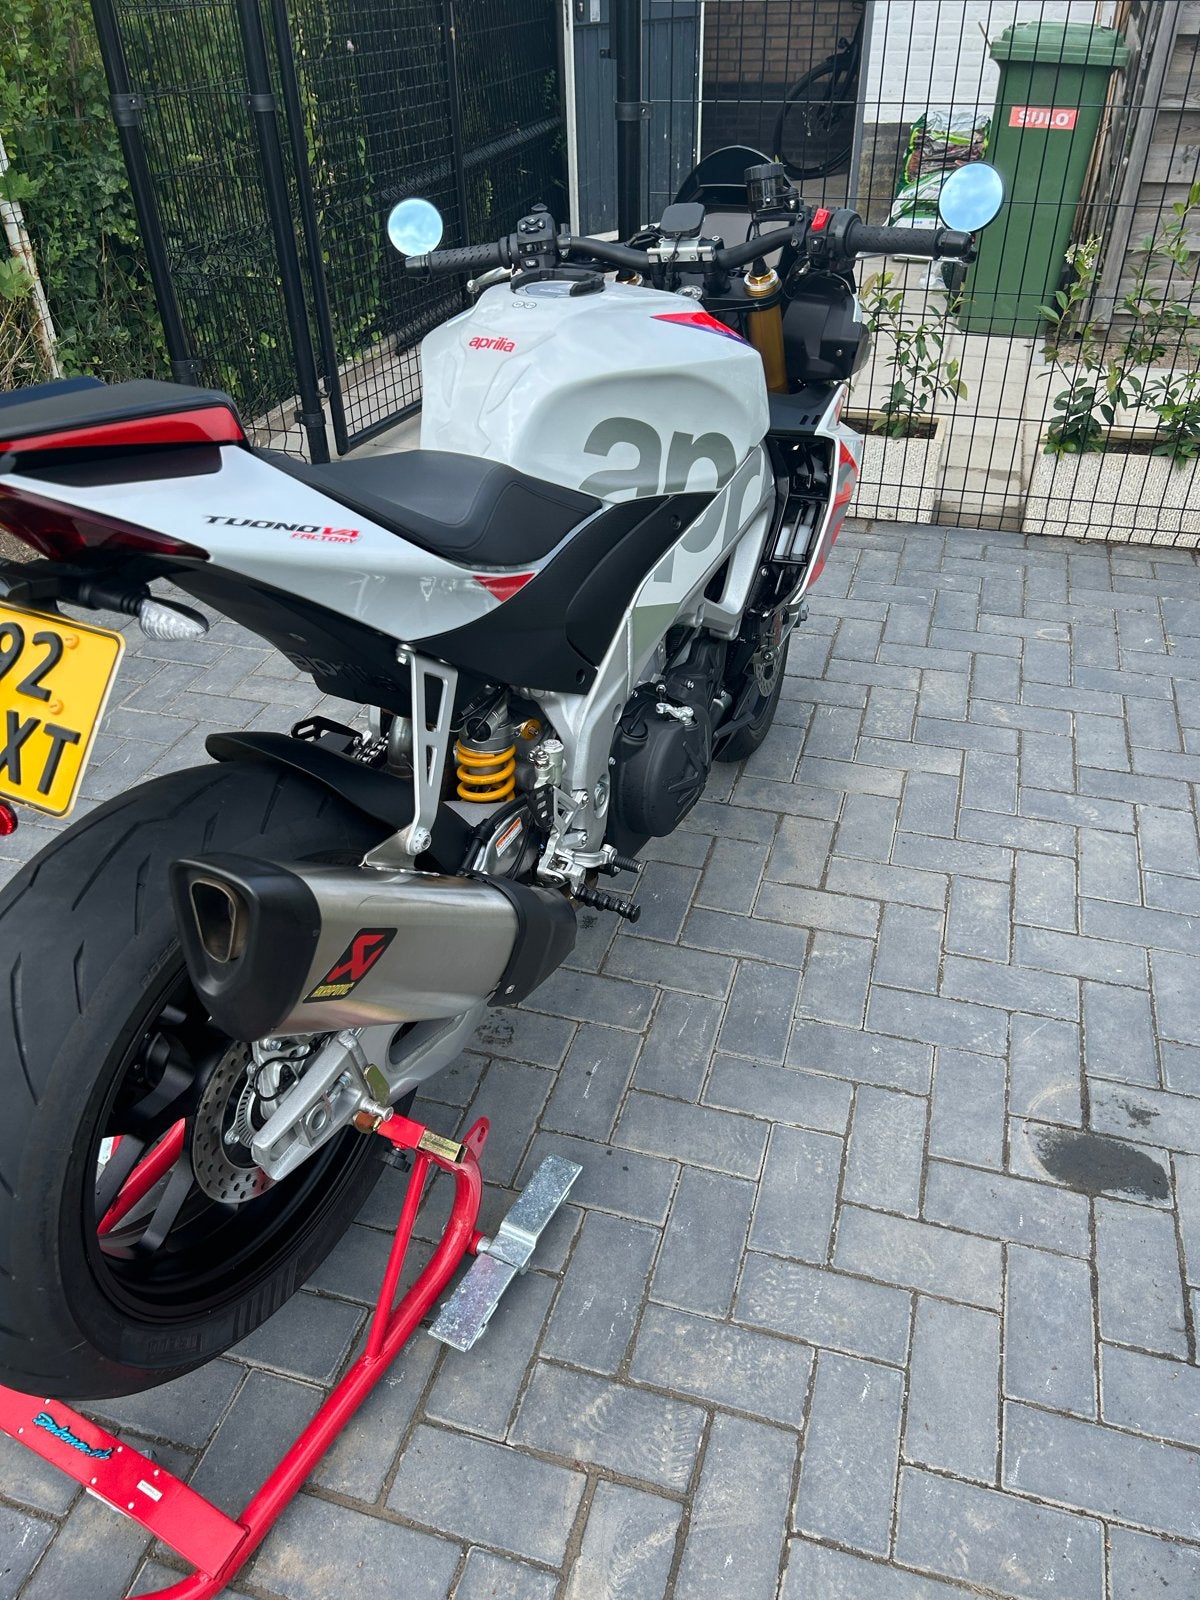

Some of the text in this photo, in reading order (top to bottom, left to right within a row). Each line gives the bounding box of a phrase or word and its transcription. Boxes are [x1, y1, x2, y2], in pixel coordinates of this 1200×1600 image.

[1017, 110, 1070, 127] SULO
[468, 336, 516, 353] aprilia
[291, 532, 357, 544] FACTORY
[0, 621, 64, 702] 92
[0, 709, 82, 796] XT
